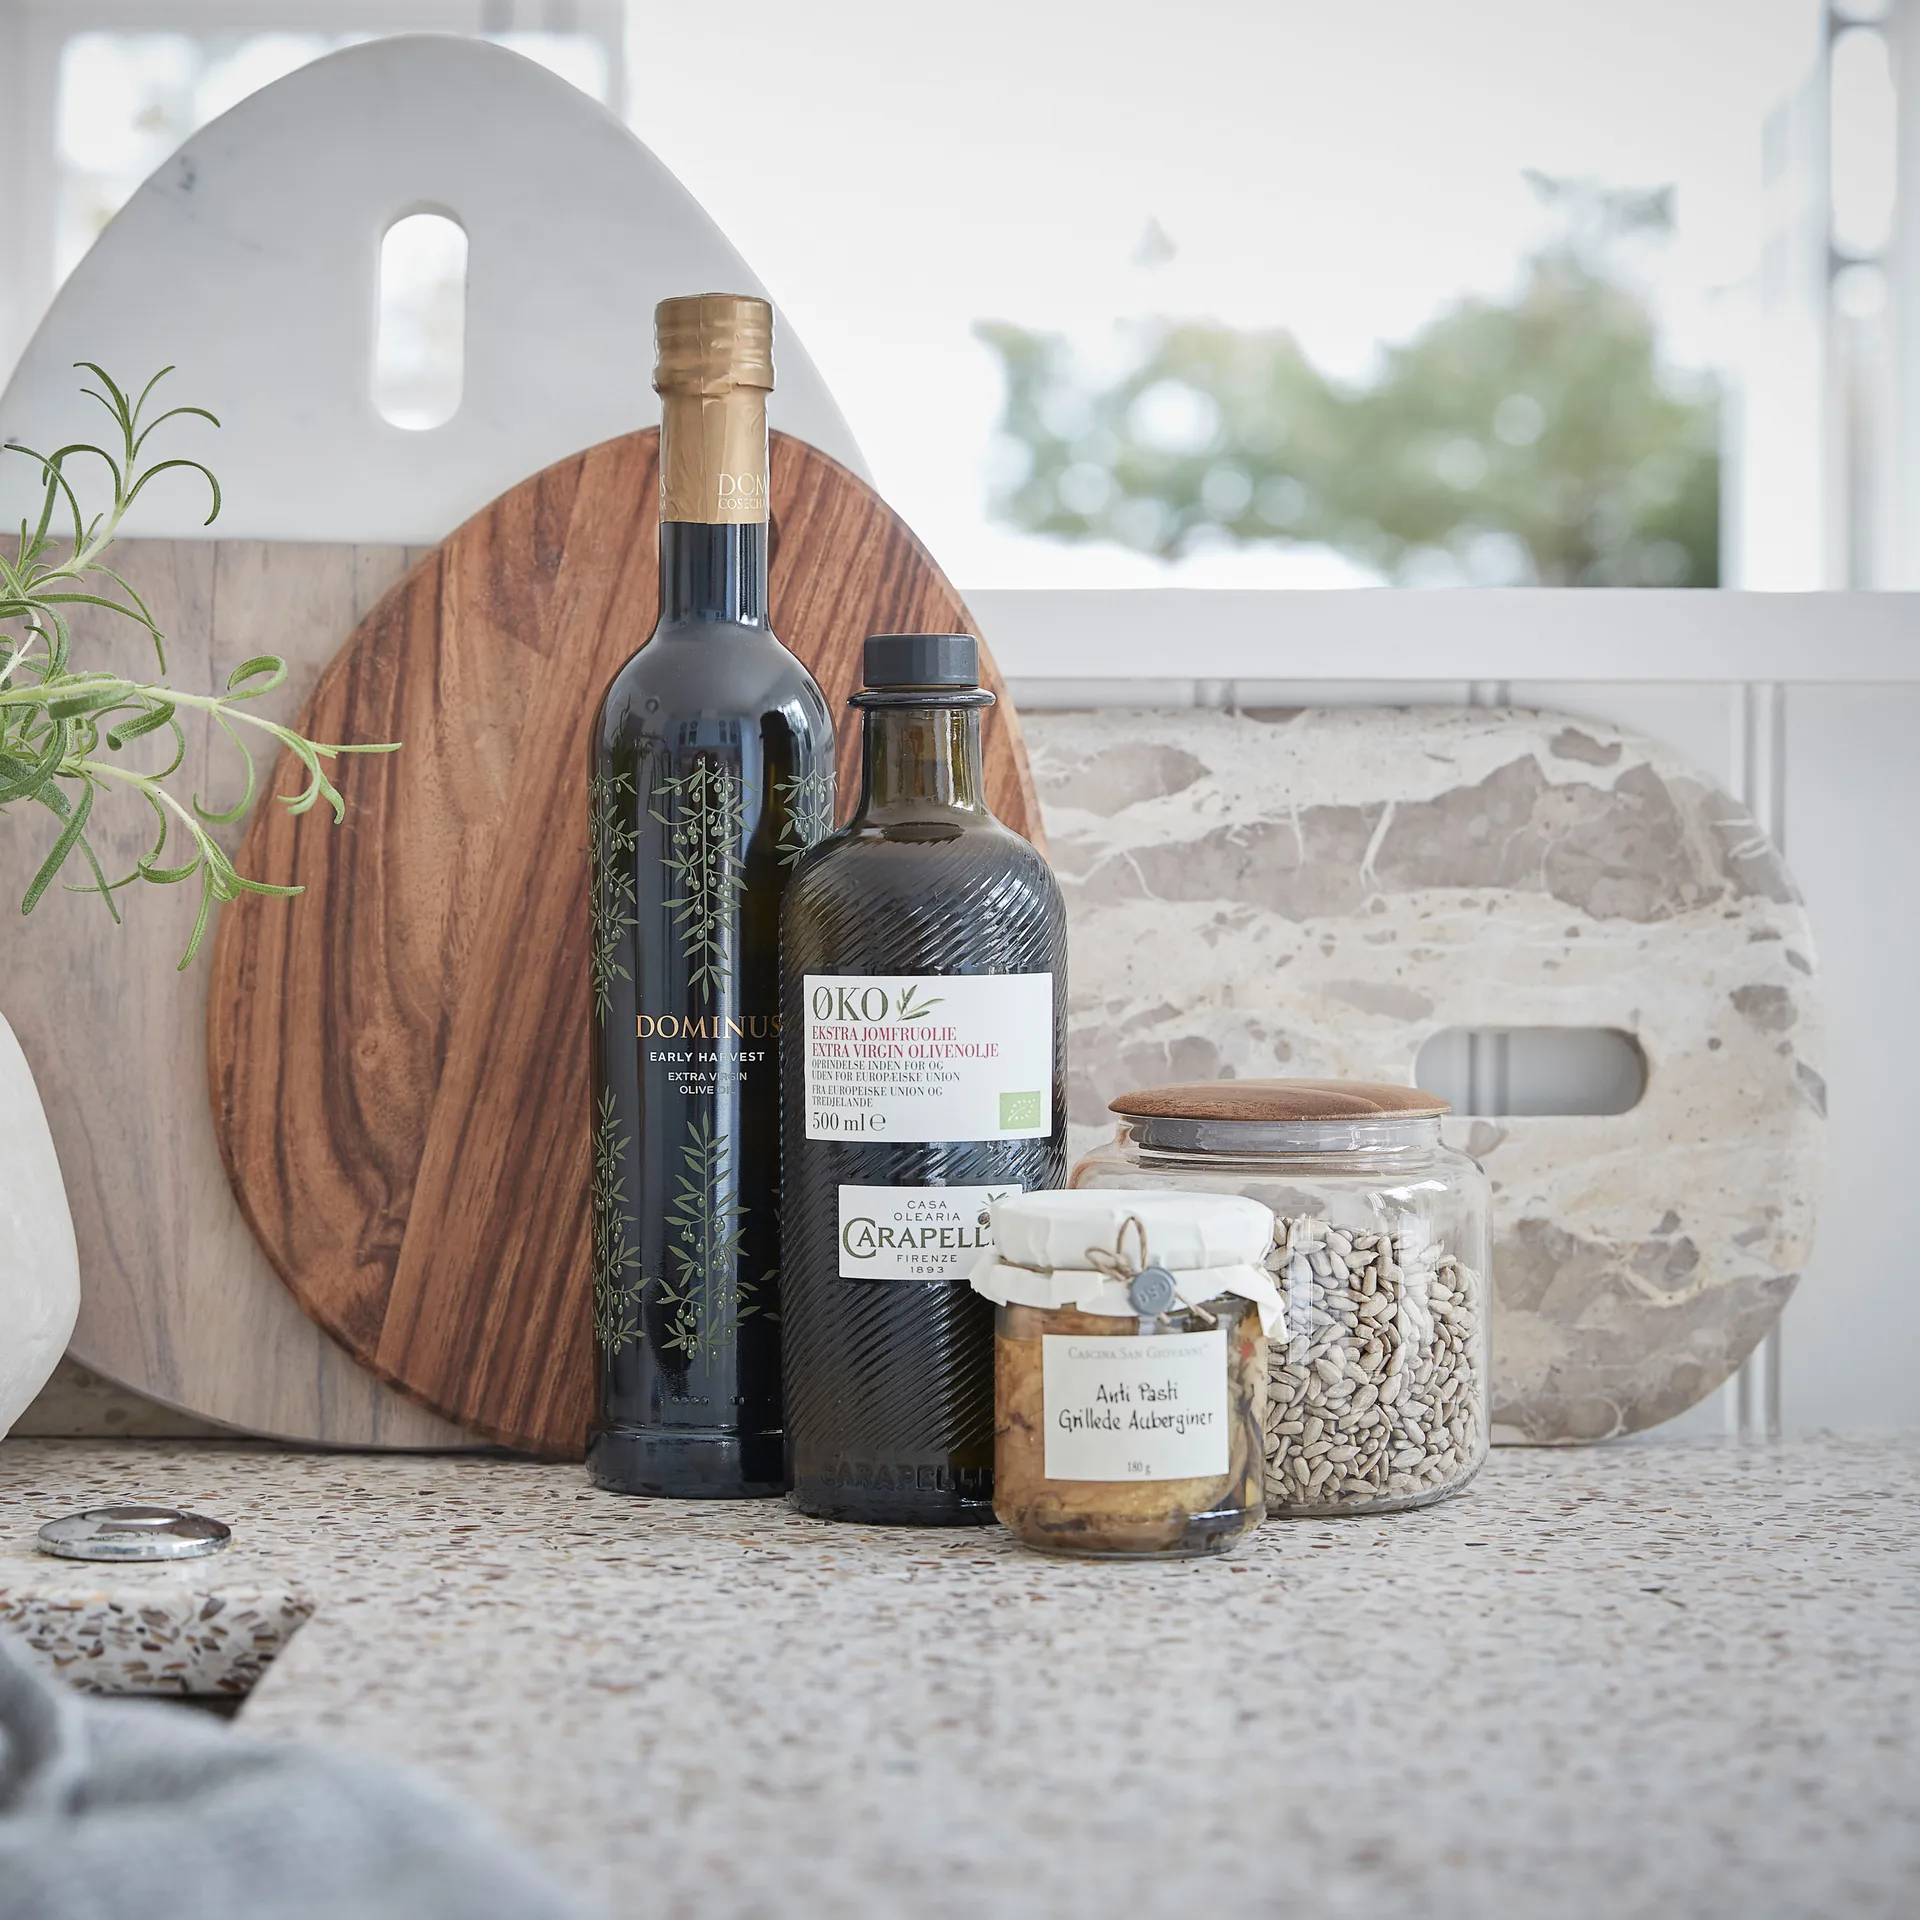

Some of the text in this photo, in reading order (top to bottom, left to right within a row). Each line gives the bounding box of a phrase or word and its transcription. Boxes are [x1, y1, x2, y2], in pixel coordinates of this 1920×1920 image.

[812, 986, 889, 1022] ØKO
[635, 1015, 781, 1039] DOMINUS
[812, 1026, 957, 1042] EKSTRA JOMFRUOLIE
[650, 1051, 765, 1062] EARLY HARVEST
[812, 1042, 1000, 1059] EXTRA VIRGIN OLIVENOLJE
[811, 1059, 944, 1071] OPRINDELSE INDEN FOR OG
[668, 1072, 748, 1081] EXTRA VIRGIN
[811, 1070, 961, 1082] UDEN FOR EUROPÆISKE UNION
[679, 1085, 736, 1095] OLIVE OIL
[812, 1084, 943, 1097] FRA EUROPEISKE UNION OG
[811, 1095, 874, 1108] TREDJELANDE
[812, 1112, 839, 1130] 500
[844, 1113, 865, 1131] ml
[907, 1200, 948, 1209] CASA
[893, 1212, 961, 1222] OLEARIA
[896, 1254, 958, 1263] FIRENZE
[910, 1266, 945, 1274] 1893
[1096, 1379, 1178, 1404] Anti Pasti
[1058, 1408, 1213, 1434] Grillede Auberginer
[1127, 1460, 1143, 1473] 180
